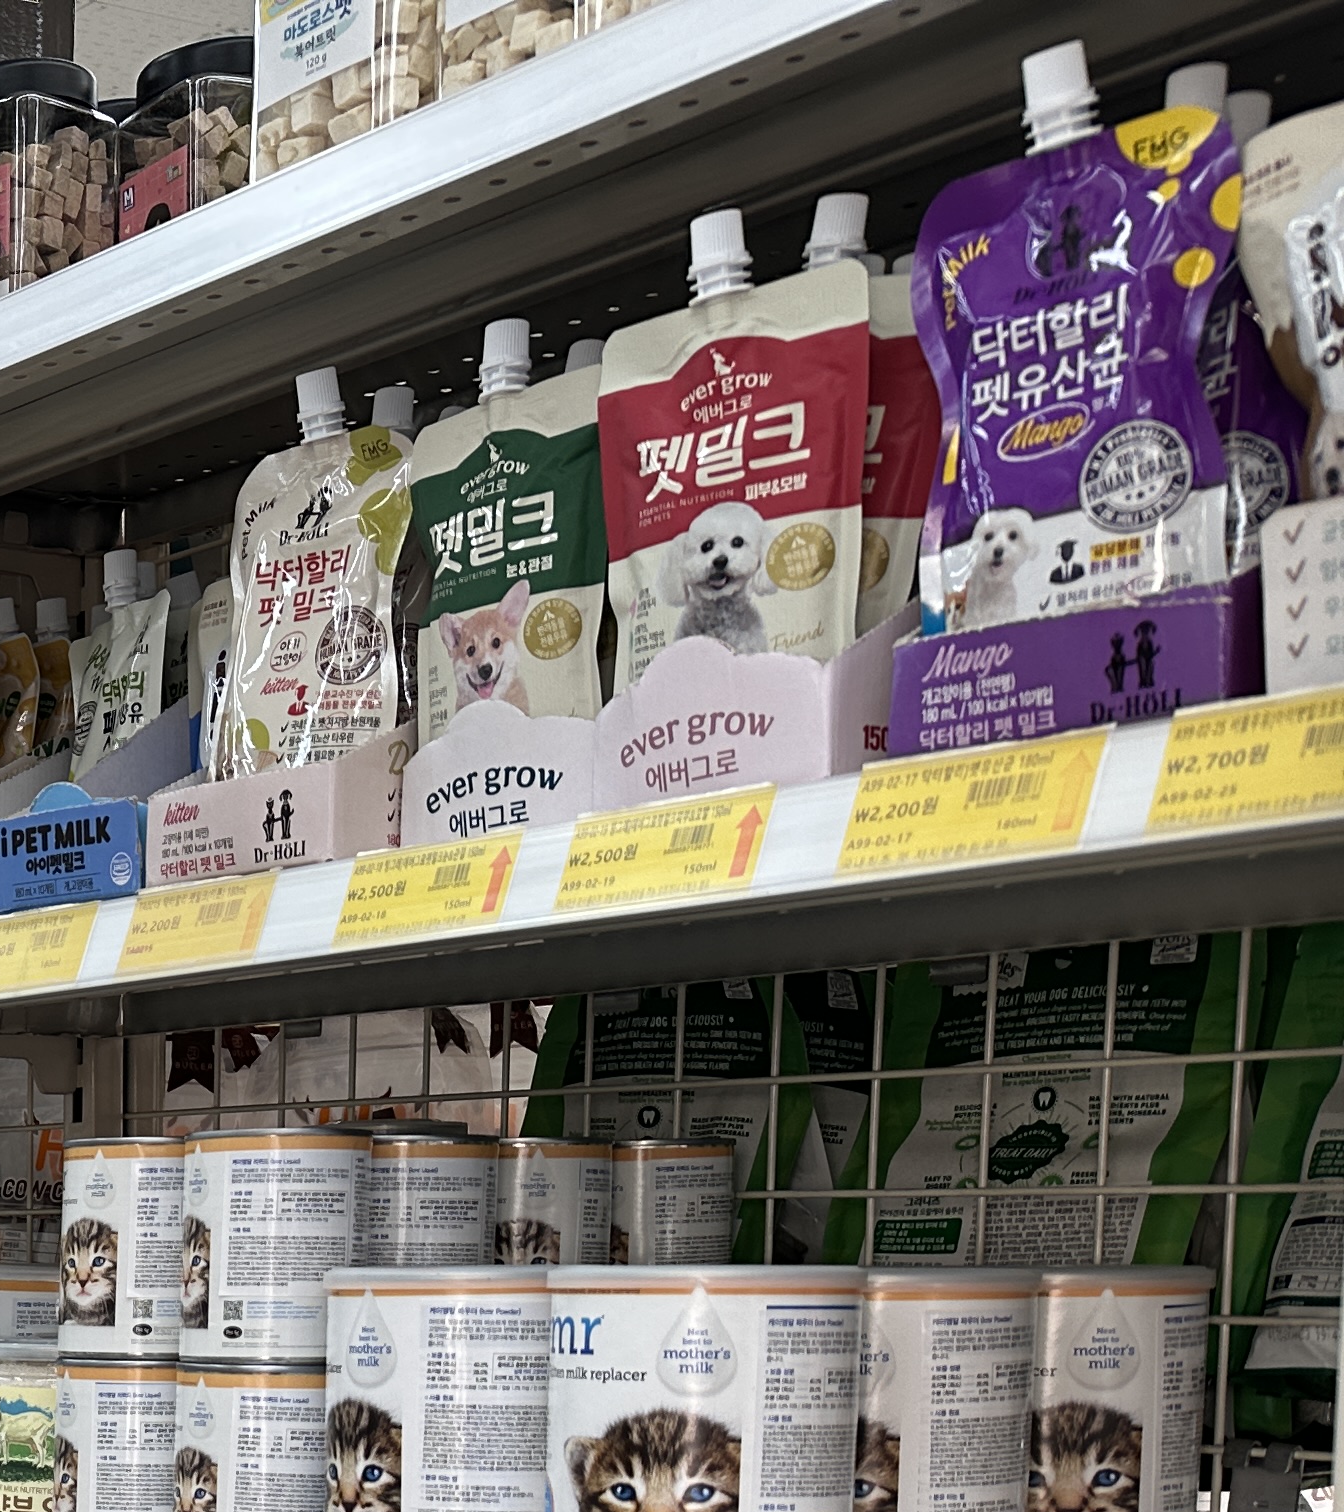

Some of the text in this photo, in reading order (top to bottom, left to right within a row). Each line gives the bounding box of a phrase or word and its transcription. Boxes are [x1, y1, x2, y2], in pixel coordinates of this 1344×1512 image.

[972, 289, 1128, 367] 닥터할리
[679, 368, 773, 412] ever grow
[972, 337, 1127, 421] 펫유산균
[692, 393, 753, 425] 에버그로
[1007, 412, 1088, 452] Mango
[636, 400, 811, 503] 펫밀크
[744, 471, 808, 501] 피부&모발
[429, 491, 558, 578] 펫밀크
[256, 544, 351, 592] 닥터할리
[273, 650, 303, 666] 고양이
[920, 640, 1013, 683] Mango
[919, 711, 1056, 750] 닥터할리 펫 밀크
[645, 748, 739, 793] 에버그로
[425, 764, 564, 816] ever grow
[163, 803, 200, 827] kitten
[448, 800, 530, 839] 에버그로
[54, 816, 111, 850] MILK
[25, 852, 86, 877] 아이펫밀크
[348, 1344, 392, 1355] mother's
[357, 1356, 380, 1367] milk
[663, 1347, 731, 1360] mother's
[1073, 1345, 1135, 1356] mother's
[1088, 1358, 1121, 1370] milk
[566, 1366, 648, 1383] milk replacer
[679, 1361, 714, 1374] milk
